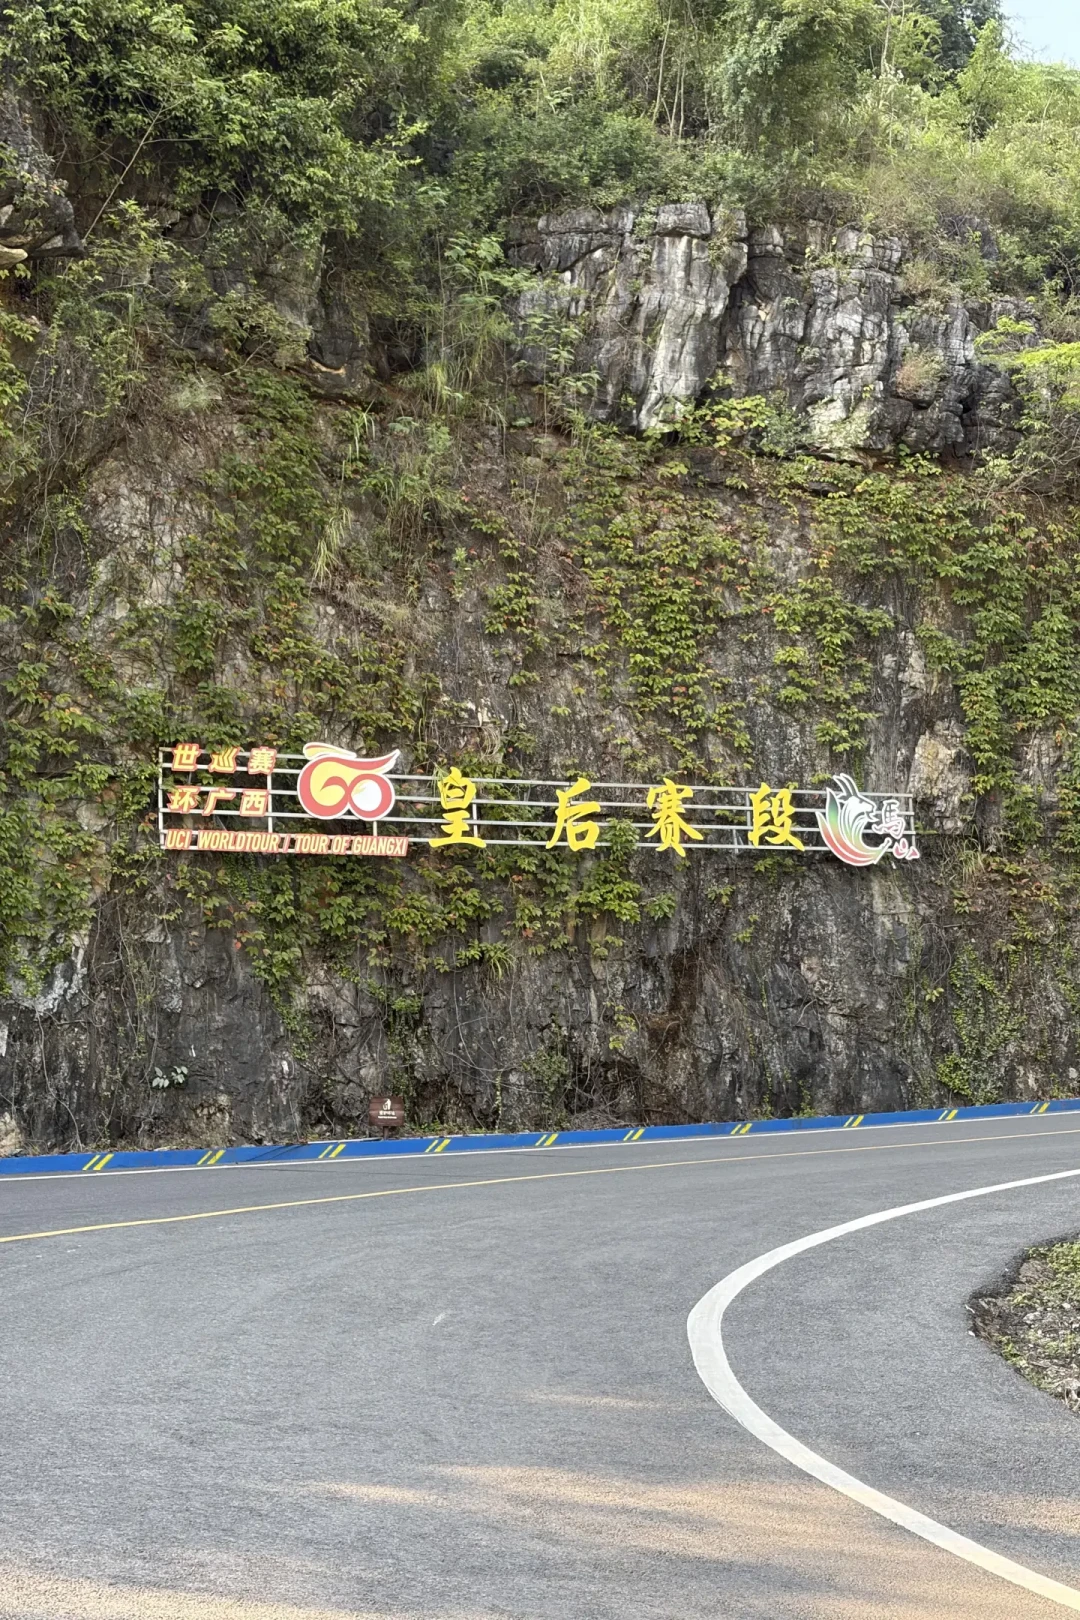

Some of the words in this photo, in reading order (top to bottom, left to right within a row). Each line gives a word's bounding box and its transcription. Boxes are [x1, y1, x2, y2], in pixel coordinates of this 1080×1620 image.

[172, 744, 276, 774] 世巡赛
[167, 786, 268, 815] 环广西
[429, 767, 805, 857] 皇后赛段
[166, 830, 192, 849] UCI
[198, 830, 280, 853] WORLDTOUR
[295, 834, 329, 854] TOUR
[332, 835, 350, 855] OF
[351, 836, 408, 856] GUANGXI
